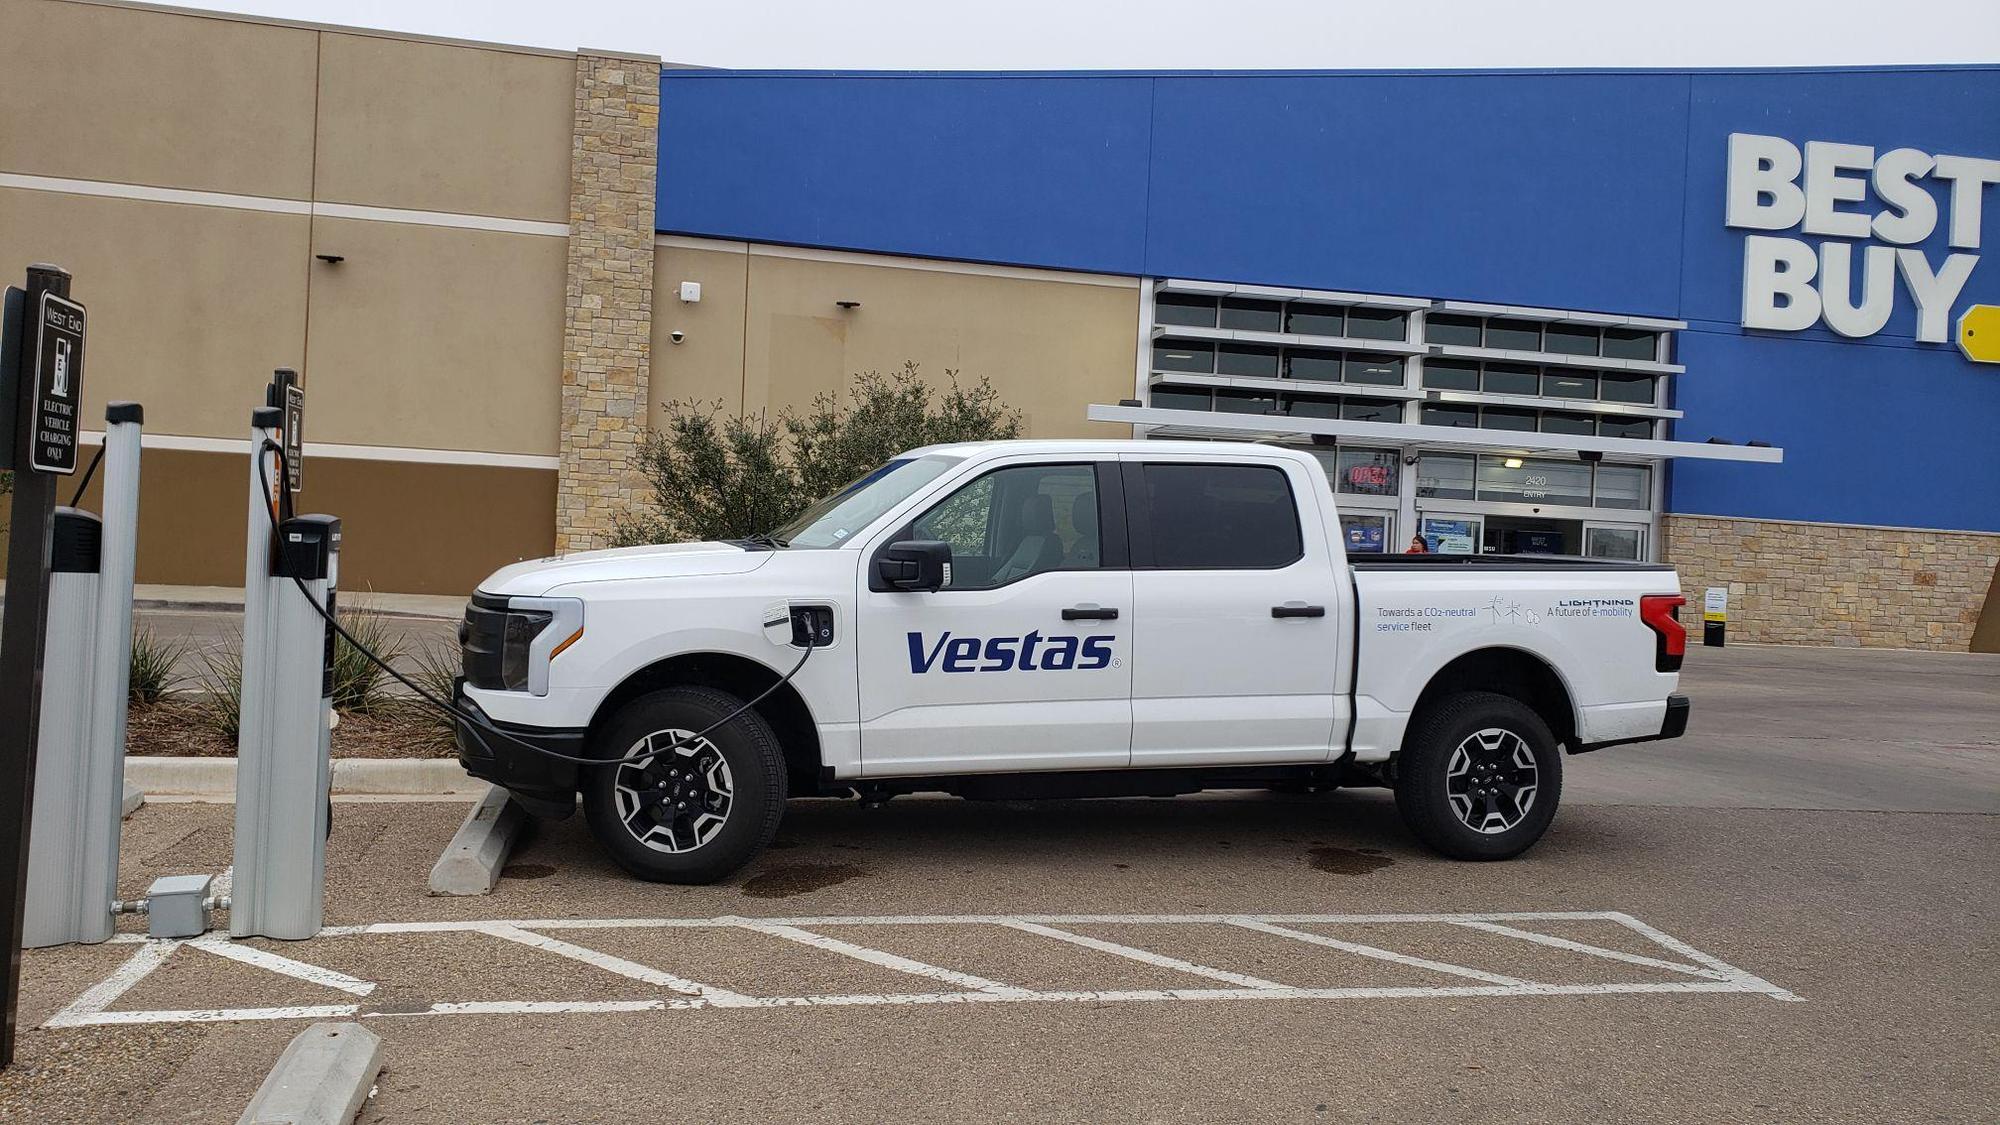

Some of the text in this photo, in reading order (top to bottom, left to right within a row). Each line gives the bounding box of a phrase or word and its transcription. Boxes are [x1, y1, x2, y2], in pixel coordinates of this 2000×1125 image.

[1725, 132, 2000, 249] BEST
[1741, 234, 1981, 343] BUY
[46, 306, 82, 332] WEST END
[43, 399, 73, 416] ELECTRIC
[44, 416, 71, 432] VEHICLE
[40, 430, 72, 446] CHARGING
[46, 446, 64, 460] ONLY
[1351, 466, 1387, 485] OPEN
[1525, 475, 1547, 486] 2420
[1523, 490, 1546, 499] ENTRY
[1559, 600, 1634, 608] LIGHTNING
[1377, 607, 1415, 617] Towards
[1417, 609, 1423, 617] a
[1547, 606, 1633, 619] A future of e-mobility
[1377, 621, 1432, 632] service fleet
